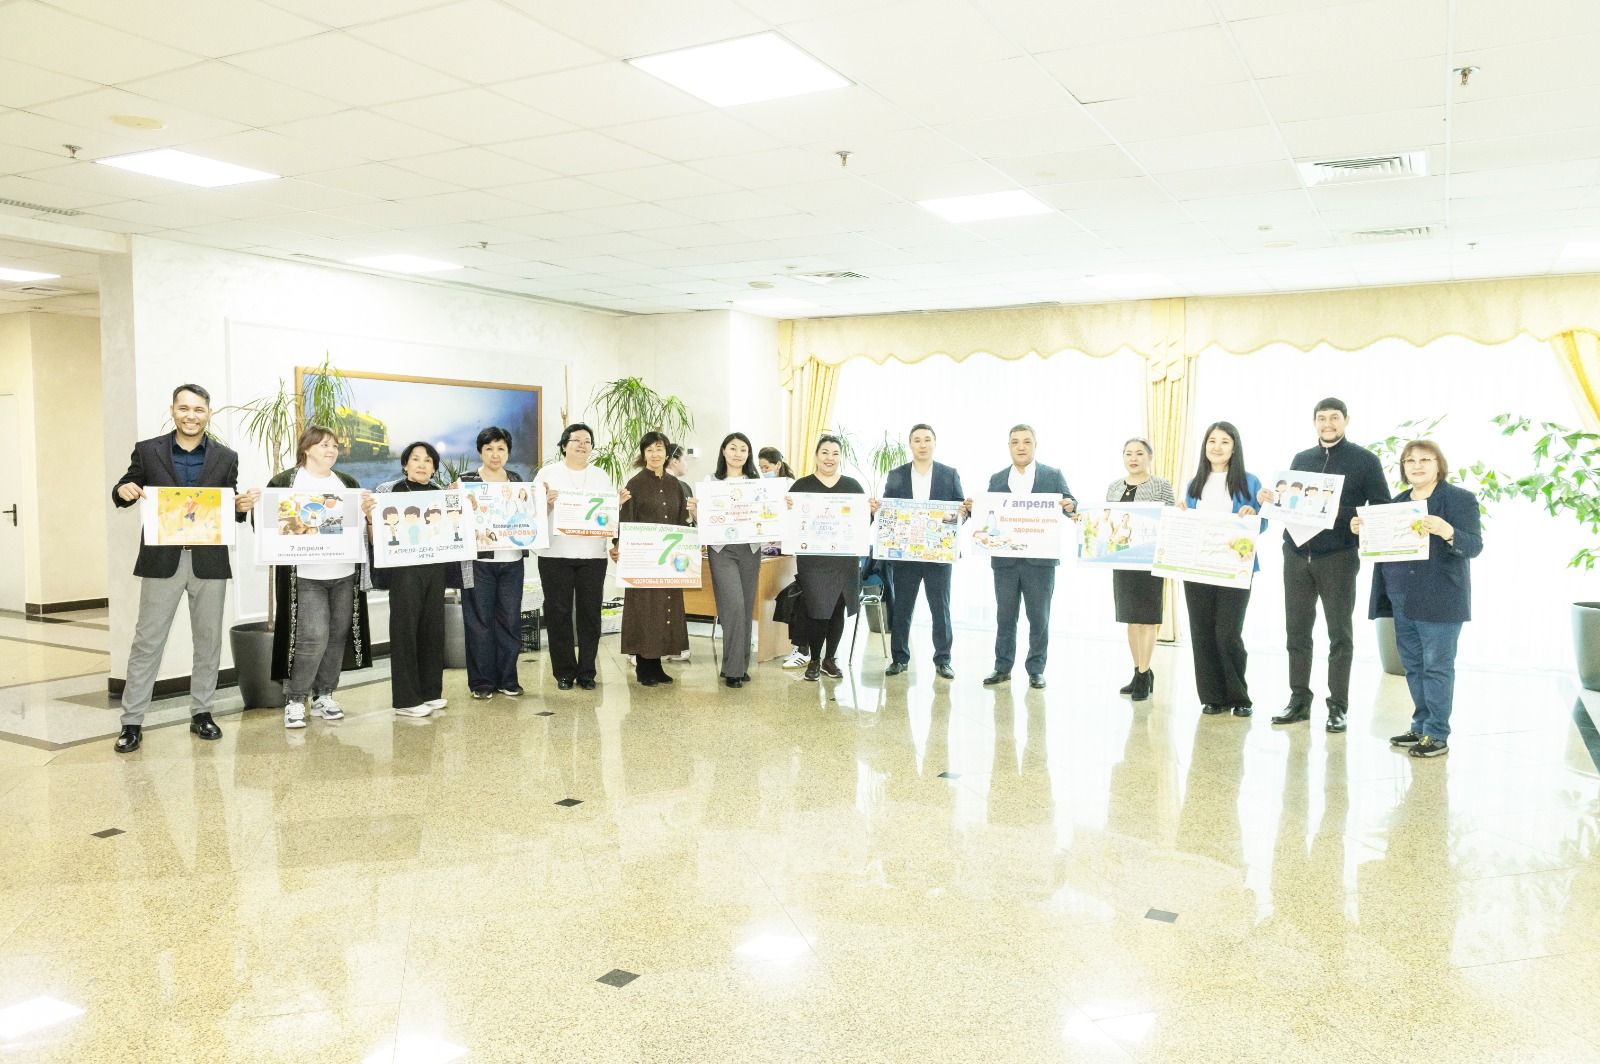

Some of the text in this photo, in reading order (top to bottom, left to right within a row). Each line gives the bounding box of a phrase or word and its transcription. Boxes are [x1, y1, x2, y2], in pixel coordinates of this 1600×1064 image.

[481, 484, 489, 495] 7
[585, 497, 604, 521] 7
[1012, 500, 1055, 510] апреля
[1000, 516, 1040, 524] Всемирный
[297, 545, 324, 553] апреля
[658, 533, 684, 566] 7
